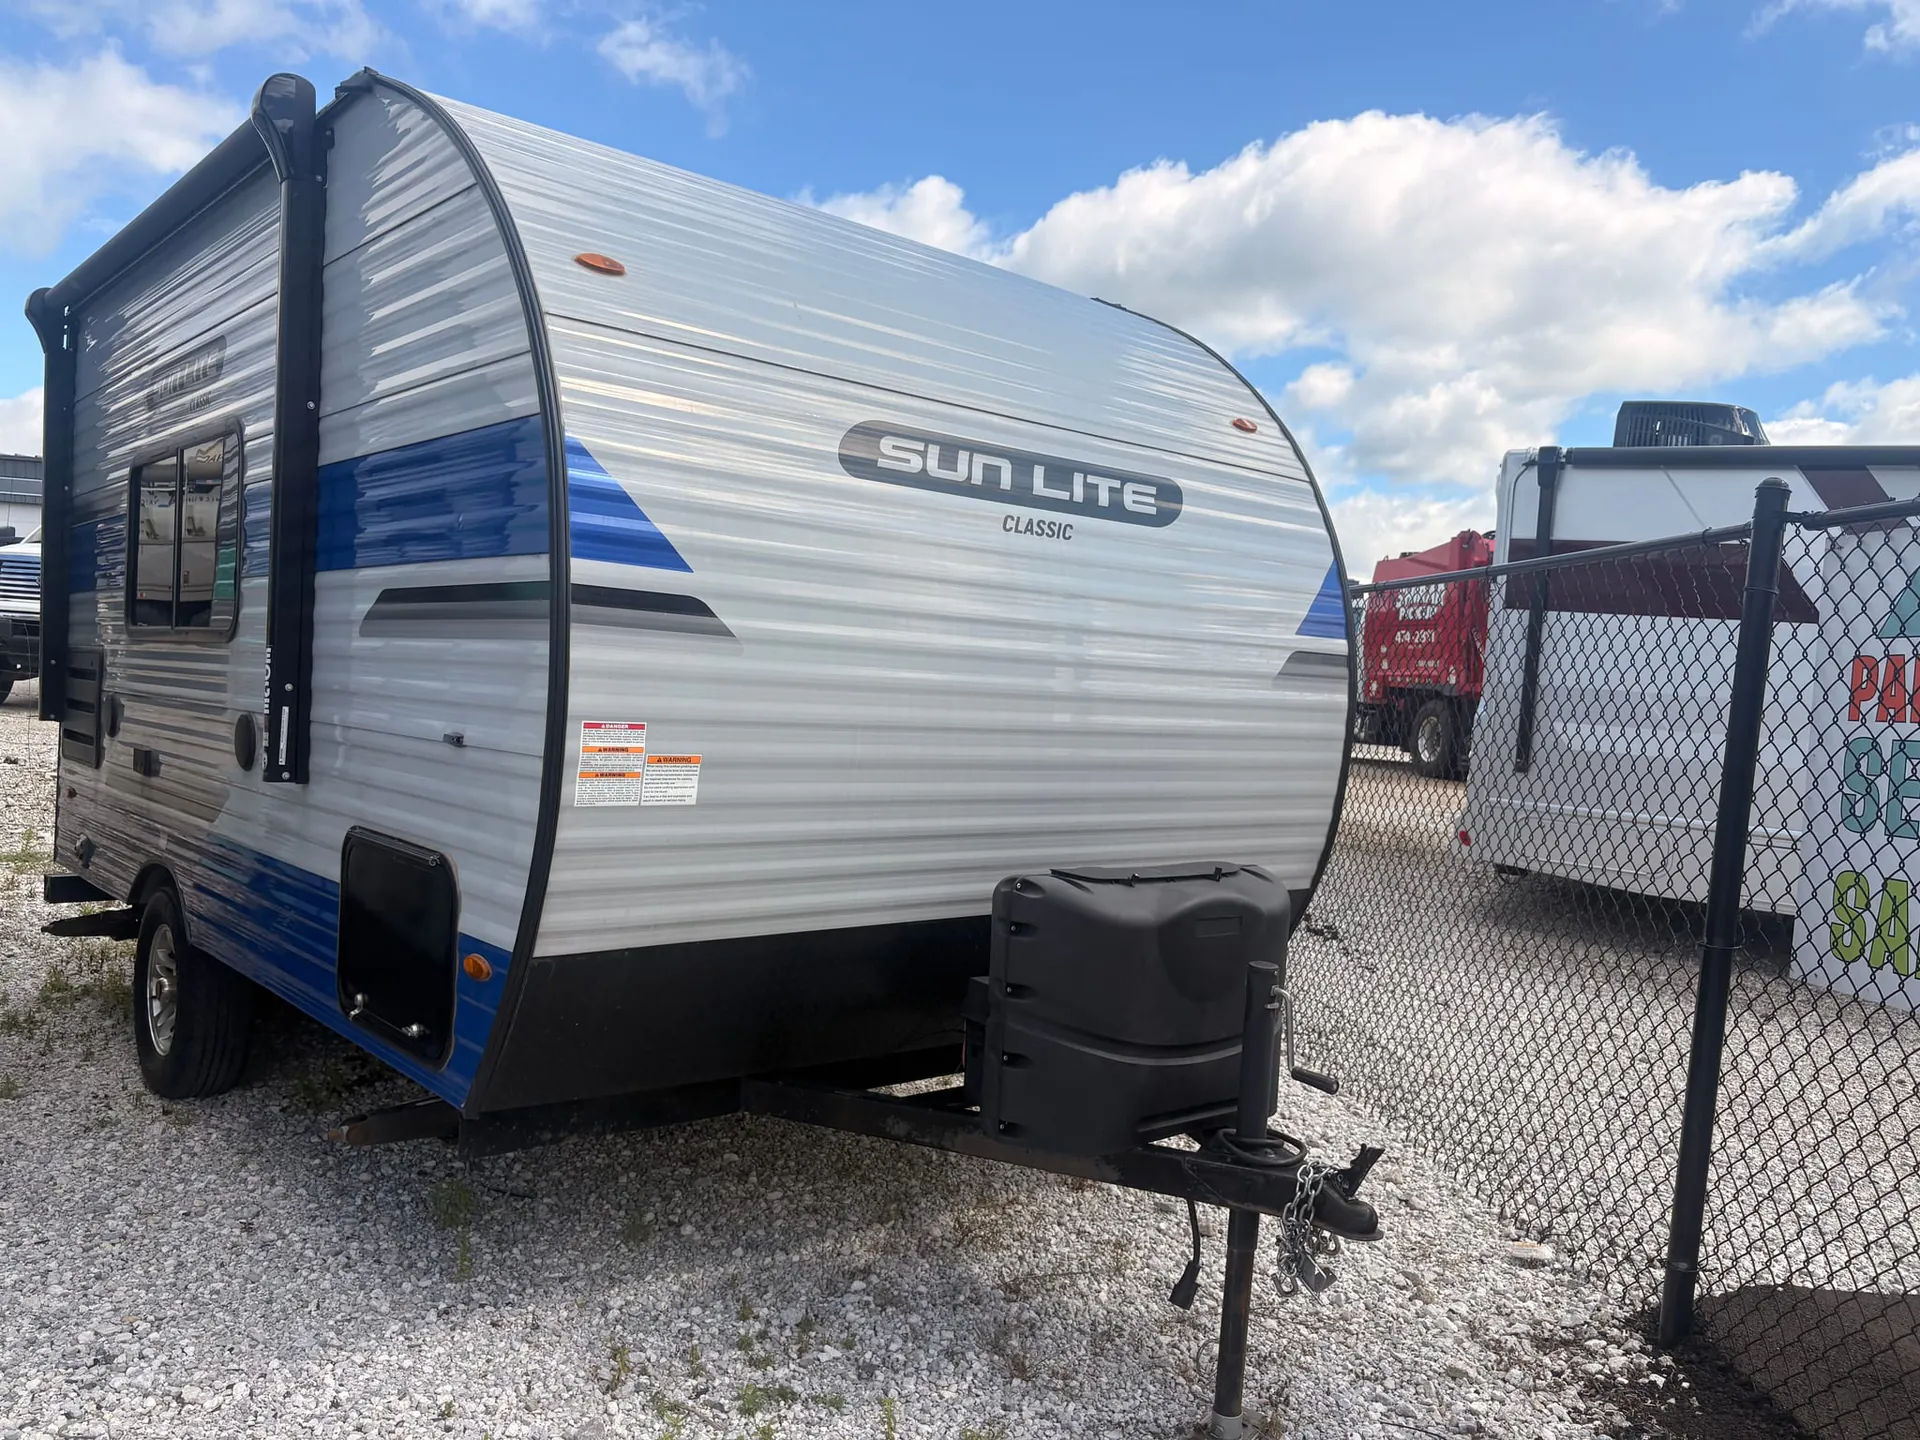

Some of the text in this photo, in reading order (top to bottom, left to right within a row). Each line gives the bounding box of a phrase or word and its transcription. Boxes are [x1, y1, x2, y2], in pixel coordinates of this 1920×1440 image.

[877, 435, 1157, 515] SUN LITE
[1001, 514, 1074, 541] CLASSIC
[1848, 654, 1920, 723] PA
[1830, 870, 1920, 980] SA
